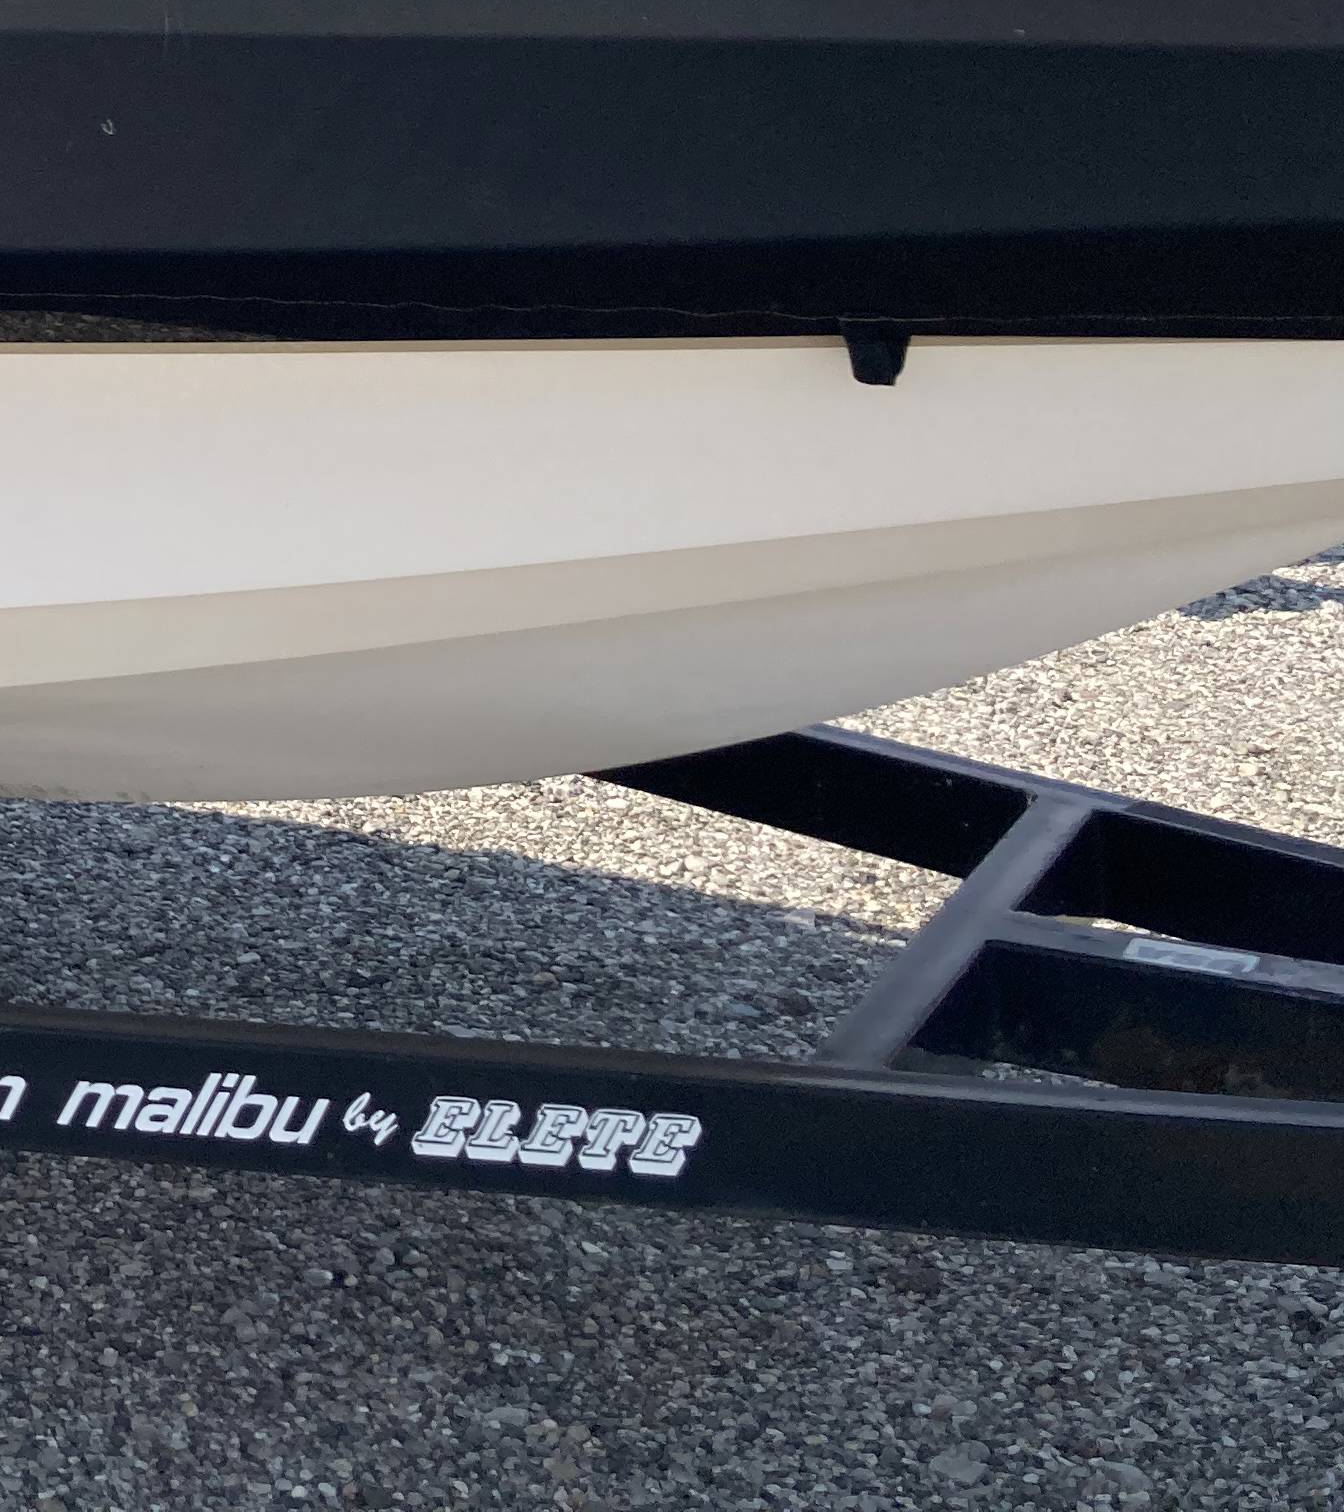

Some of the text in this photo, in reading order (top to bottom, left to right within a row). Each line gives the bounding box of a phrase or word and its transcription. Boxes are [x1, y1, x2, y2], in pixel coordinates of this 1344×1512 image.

[56, 1072, 330, 1144] malibu
[342, 1092, 399, 1146] by
[411, 1095, 703, 1176] ELETE
